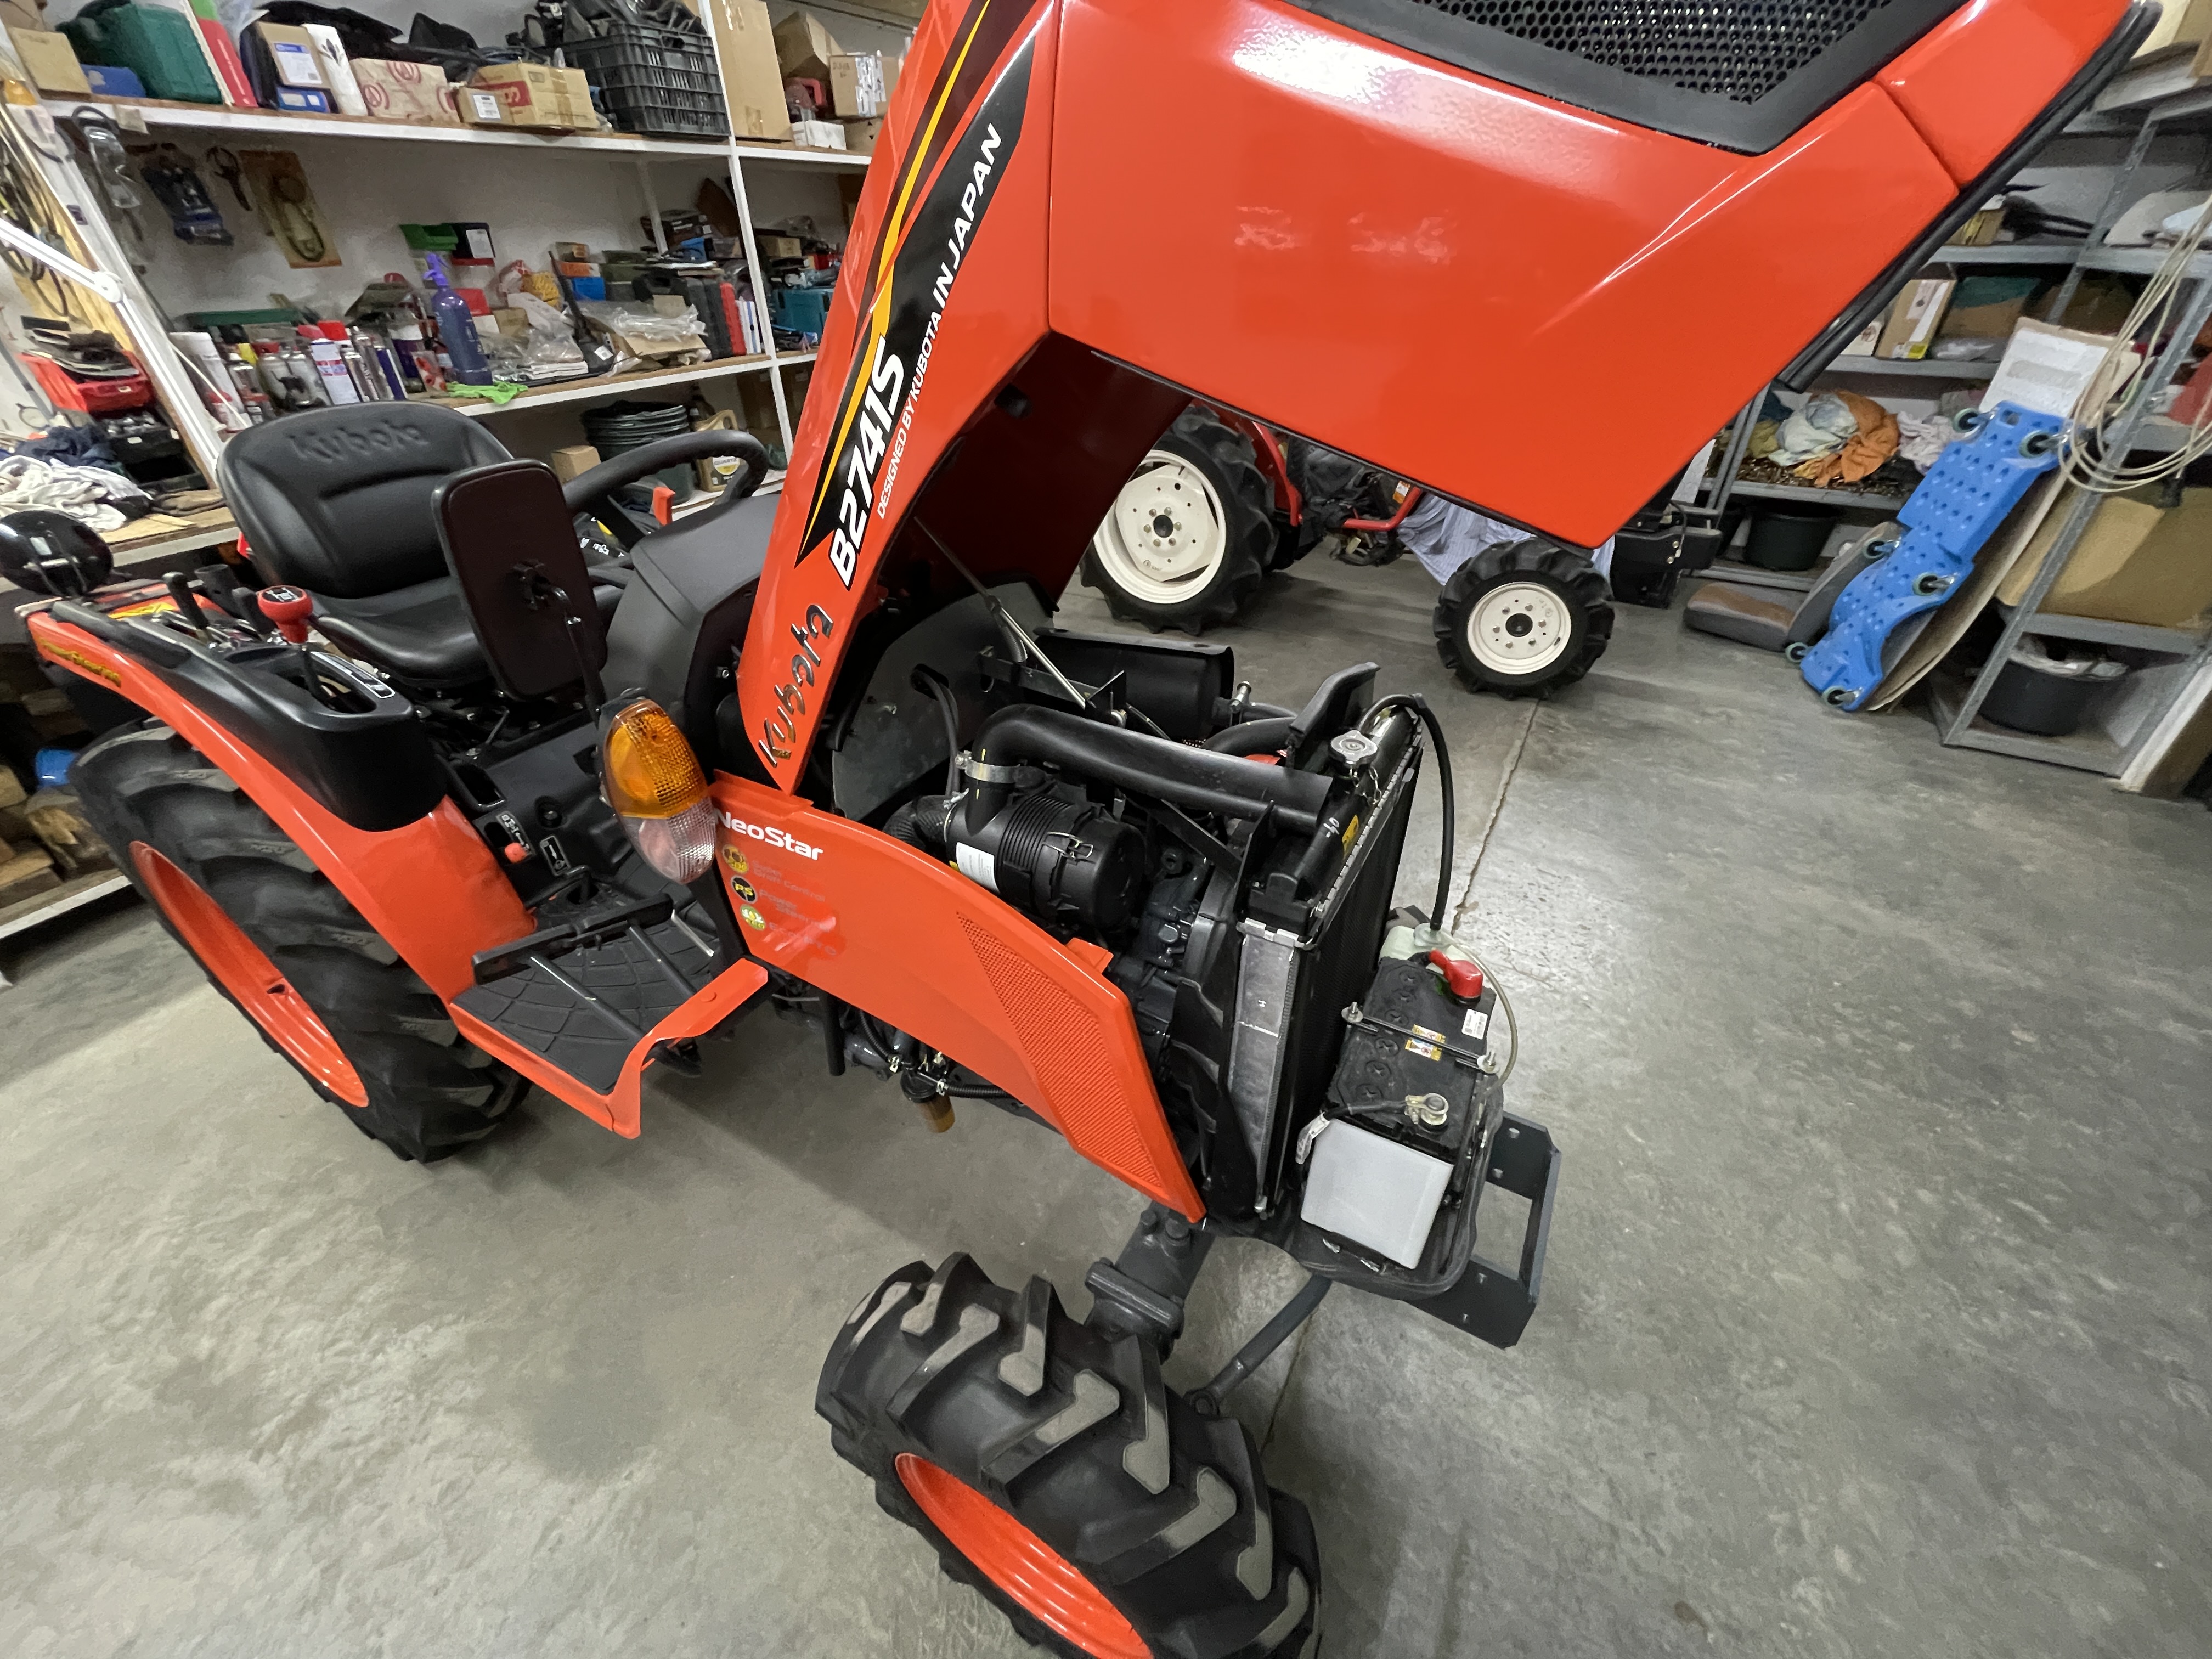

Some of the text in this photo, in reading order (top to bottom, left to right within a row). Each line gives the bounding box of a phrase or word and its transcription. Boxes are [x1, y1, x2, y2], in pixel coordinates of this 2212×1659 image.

[877, 122, 1002, 520] DESIGNED BY KUBOTA IN JAPAN
[713, 457, 737, 466] QUARTZ
[830, 337, 905, 588] B2741S
[758, 603, 834, 768] Kubota
[715, 808, 824, 861] NeoStar
[735, 883, 754, 896] PS
